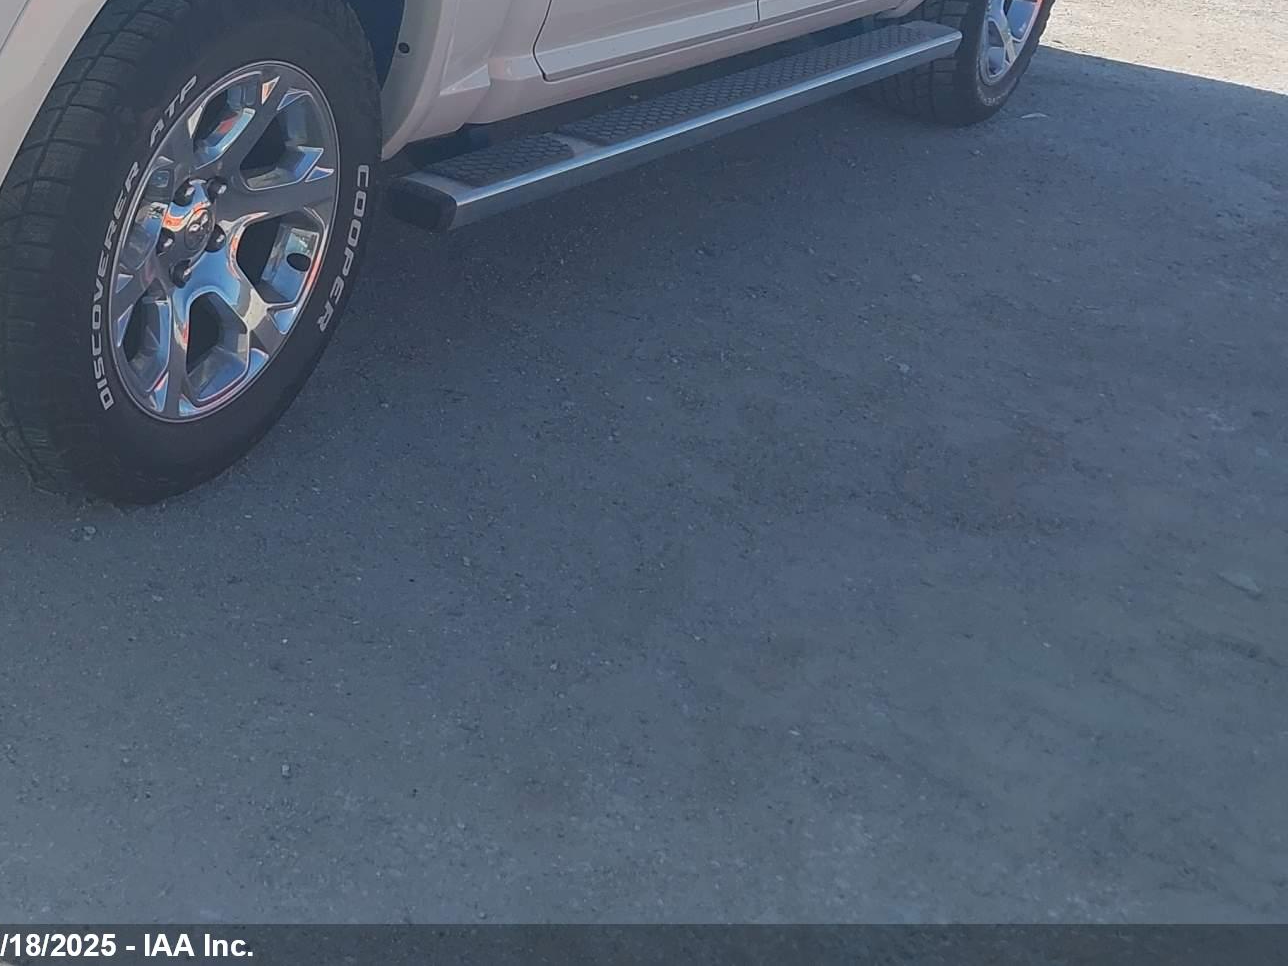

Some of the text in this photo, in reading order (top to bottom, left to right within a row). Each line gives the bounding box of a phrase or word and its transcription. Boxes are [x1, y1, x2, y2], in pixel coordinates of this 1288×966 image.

[90, 74, 198, 411] DISCOVERER ATP
[316, 163, 371, 333] COOPER
